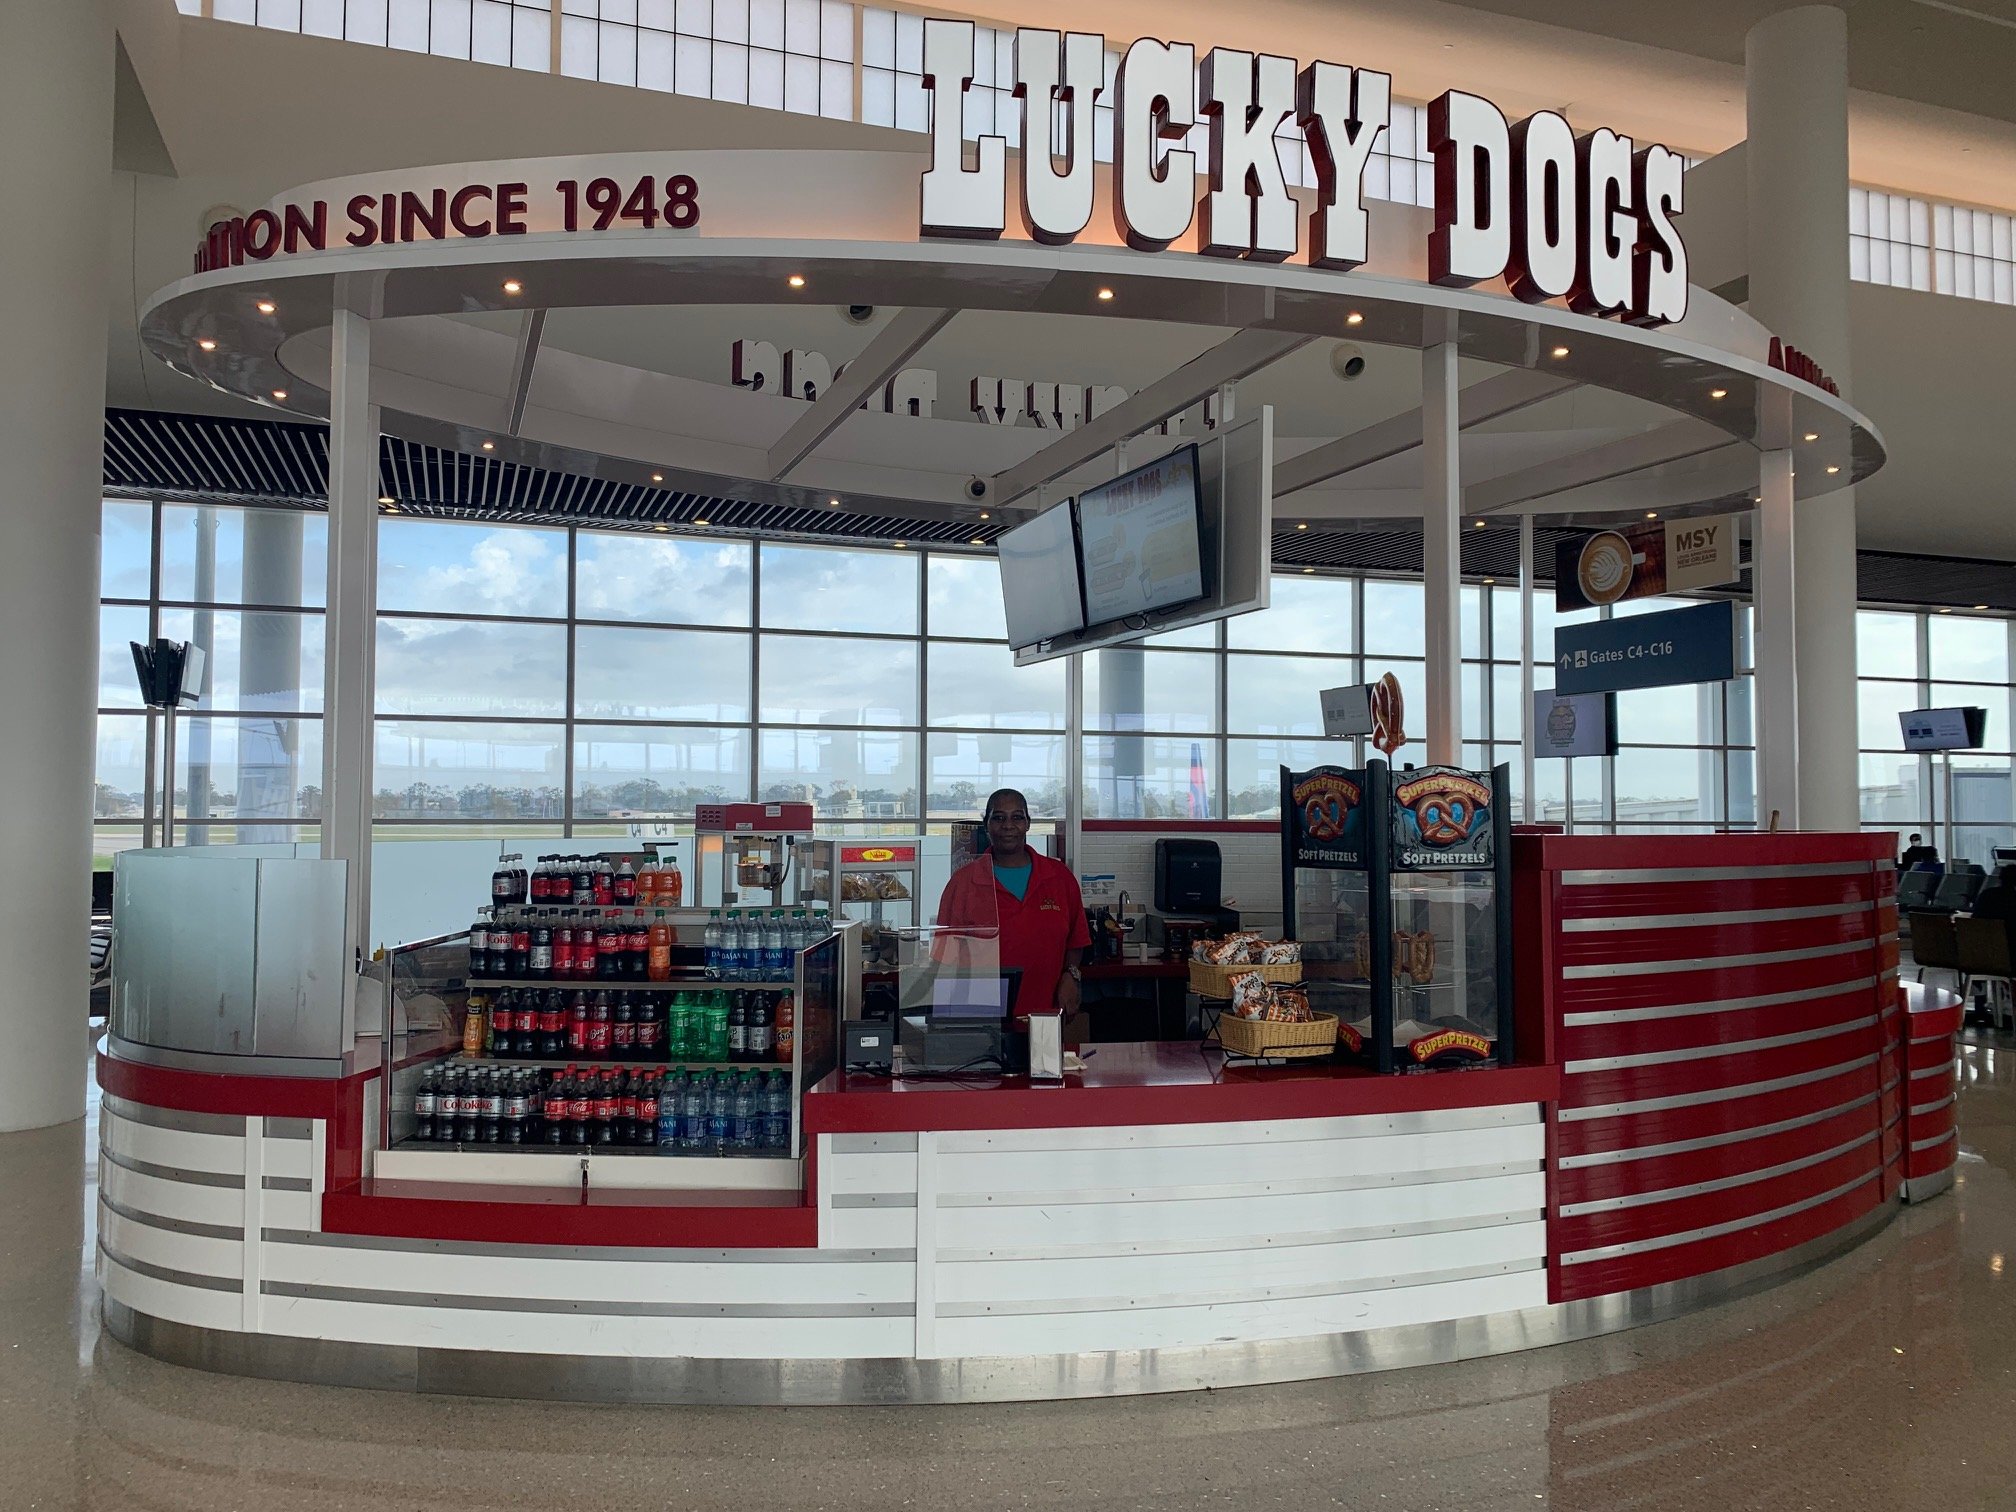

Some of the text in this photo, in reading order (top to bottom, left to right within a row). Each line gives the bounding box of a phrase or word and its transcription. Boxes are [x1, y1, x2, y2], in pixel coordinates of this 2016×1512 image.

[919, 18, 1688, 326] LUCKY DOGS
[345, 181, 528, 248] SINCE
[556, 174, 700, 232] 1948
[1676, 525, 1718, 552] MSY
[1590, 641, 1673, 664] Gates C4-C16
[1298, 848, 1358, 863] SOFT PRETZELS
[1403, 852, 1486, 865] SOFT PRETZELS
[1417, 1031, 1490, 1059] SUPERPRETZEL
